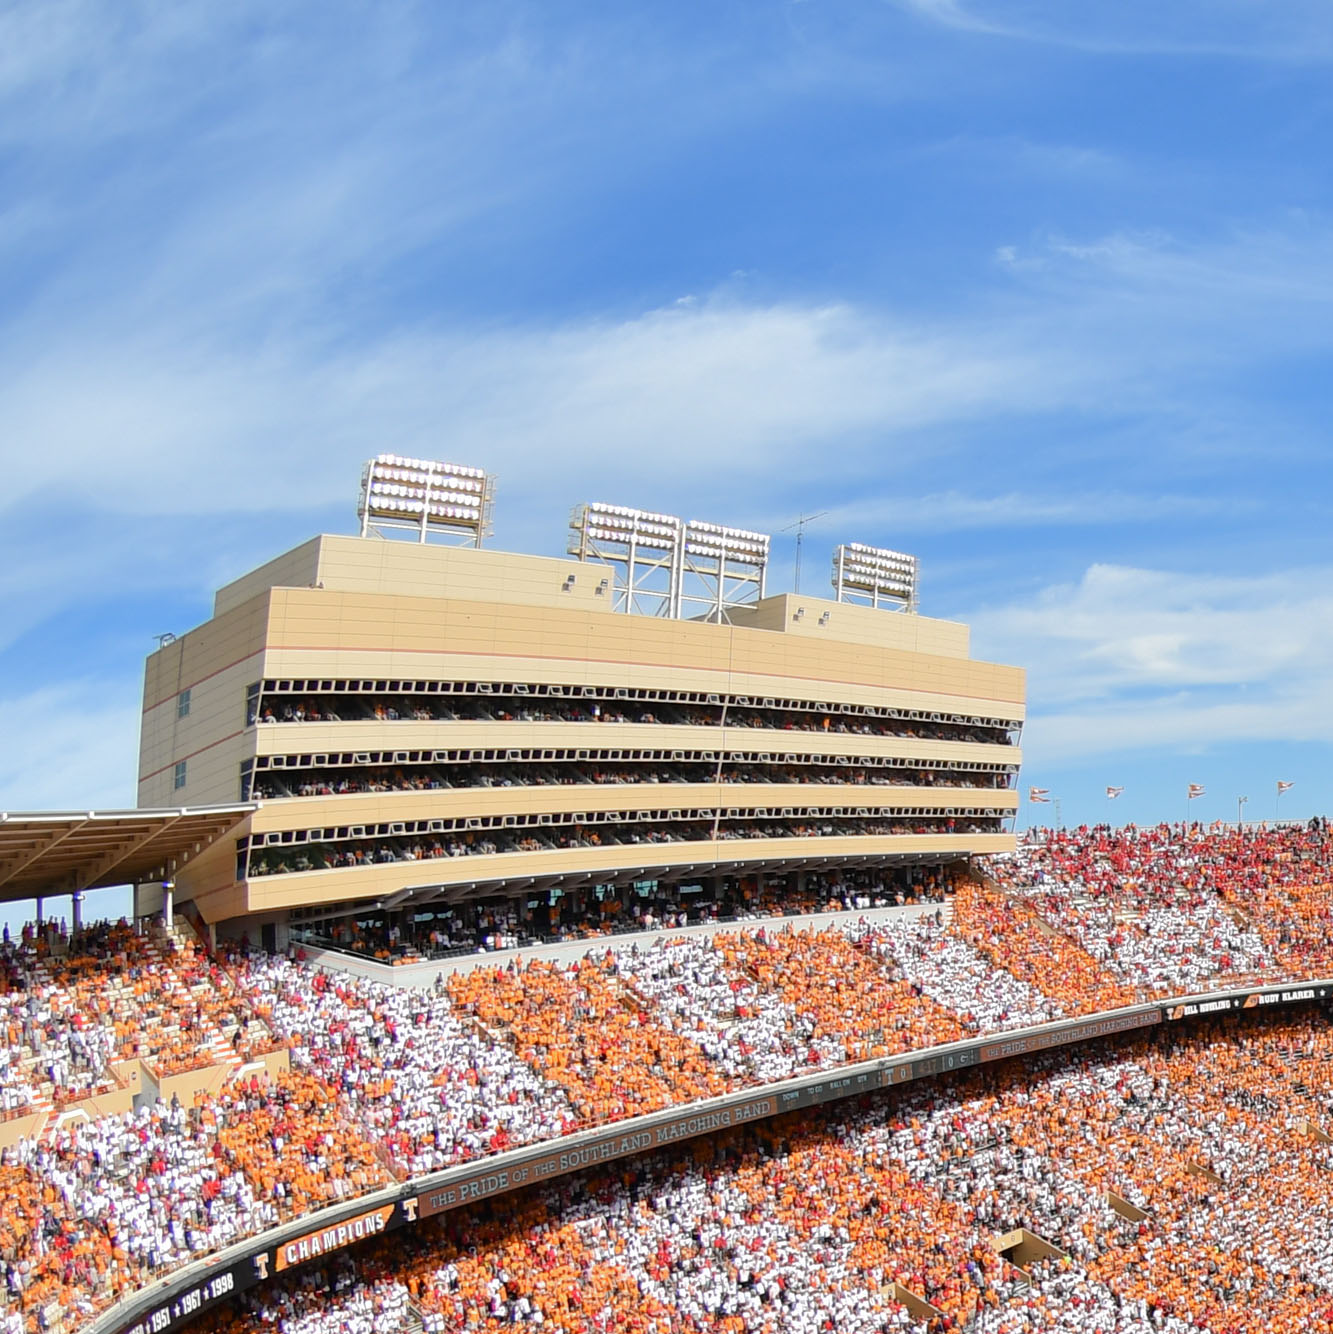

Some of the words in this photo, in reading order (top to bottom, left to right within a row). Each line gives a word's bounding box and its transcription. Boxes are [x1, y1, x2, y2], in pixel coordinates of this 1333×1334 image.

[1001, 1041, 1026, 1055] PRIDE
[1051, 1026, 1097, 1044] SOUTHLAND
[431, 1190, 457, 1209] THE
[459, 1171, 509, 1201] PRIDE
[512, 1167, 529, 1183] OF
[533, 1160, 556, 1177] THE
[560, 1131, 652, 1169] SOUTHLAND
[656, 1108, 731, 1142] MARCHING
[735, 1101, 771, 1122] BAND
[286, 1213, 385, 1263] CHAMPIONS
[151, 1306, 171, 1333] 1951
[182, 1289, 202, 1315] 1967
[210, 1272, 234, 1298] 1998
